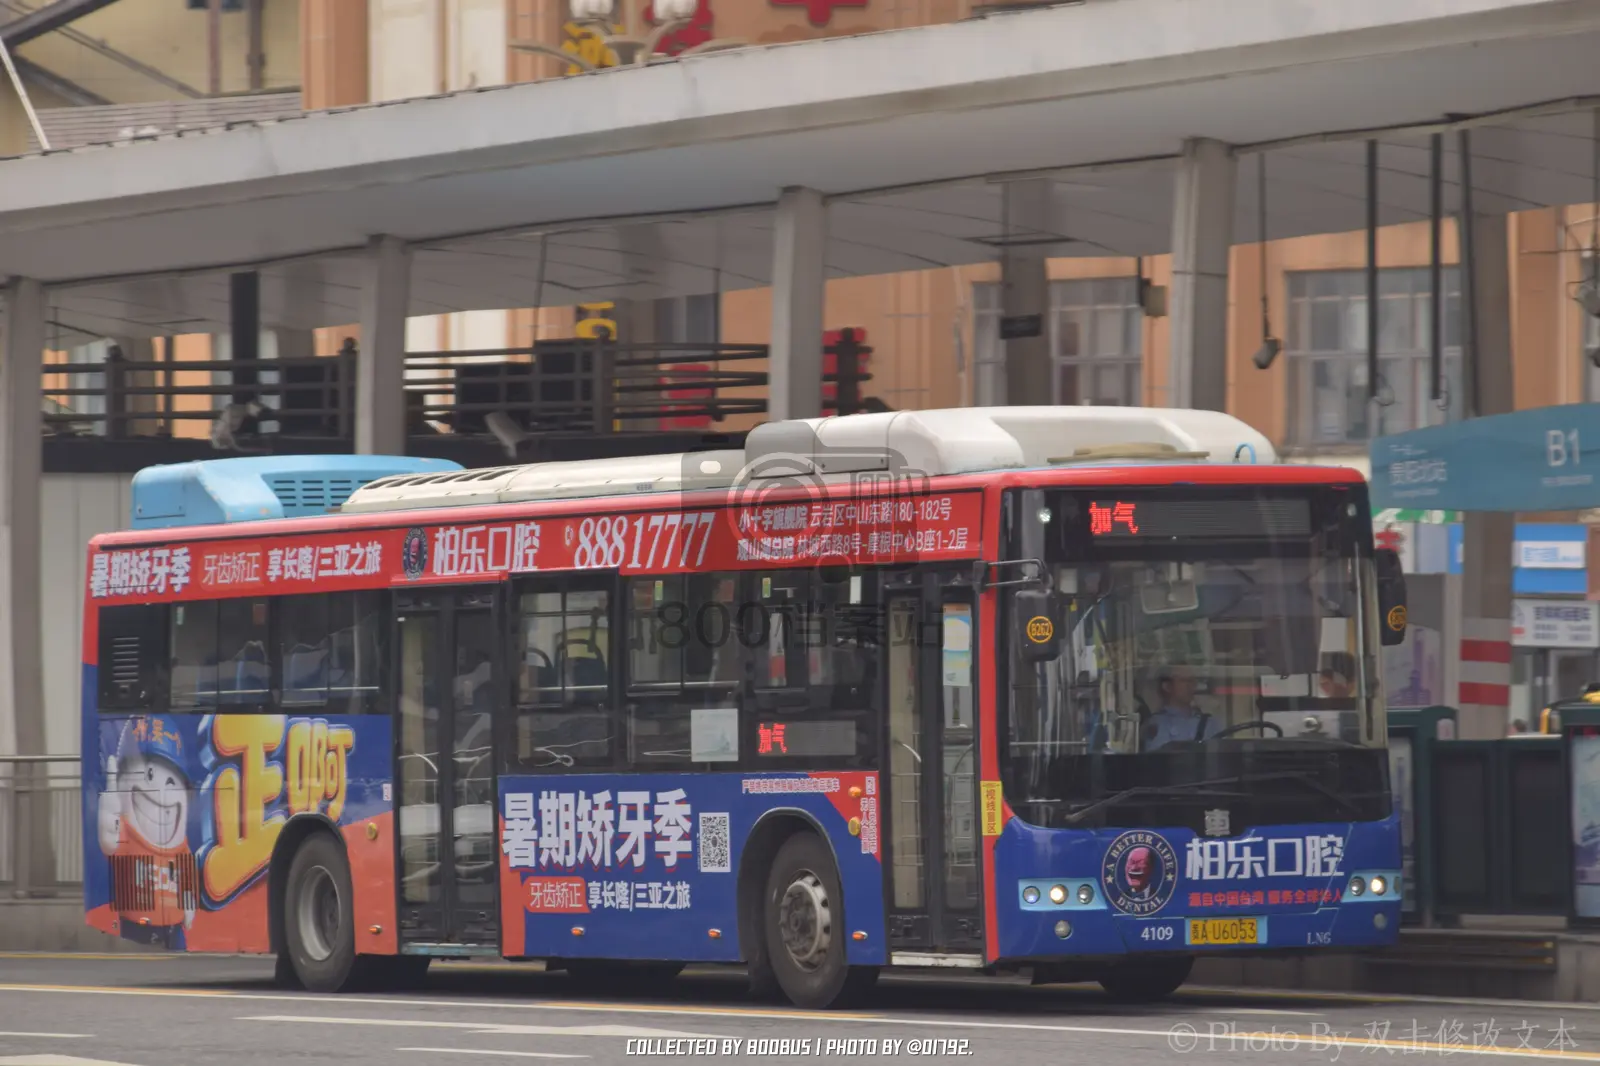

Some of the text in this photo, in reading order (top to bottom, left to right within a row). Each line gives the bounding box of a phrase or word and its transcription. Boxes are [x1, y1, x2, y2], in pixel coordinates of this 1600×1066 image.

[1546, 428, 1580, 466] B1
[1089, 501, 1138, 536] 加气
[433, 522, 541, 575] 柏乐口腔
[574, 512, 716, 570] 88817777
[90, 547, 191, 597] 暑期矫牙季
[202, 551, 261, 585] 牙齿矫正
[502, 788, 693, 868] 暑期矫牙季
[1106, 834, 1174, 872] A BETTER LIFE
[1185, 835, 1345, 880] 柏乐口腔
[530, 881, 690, 911] 牙齿矫正 享长隆/三亚之旅
[1117, 896, 1163, 912] DENTAL
[1141, 927, 1173, 940] 4109
